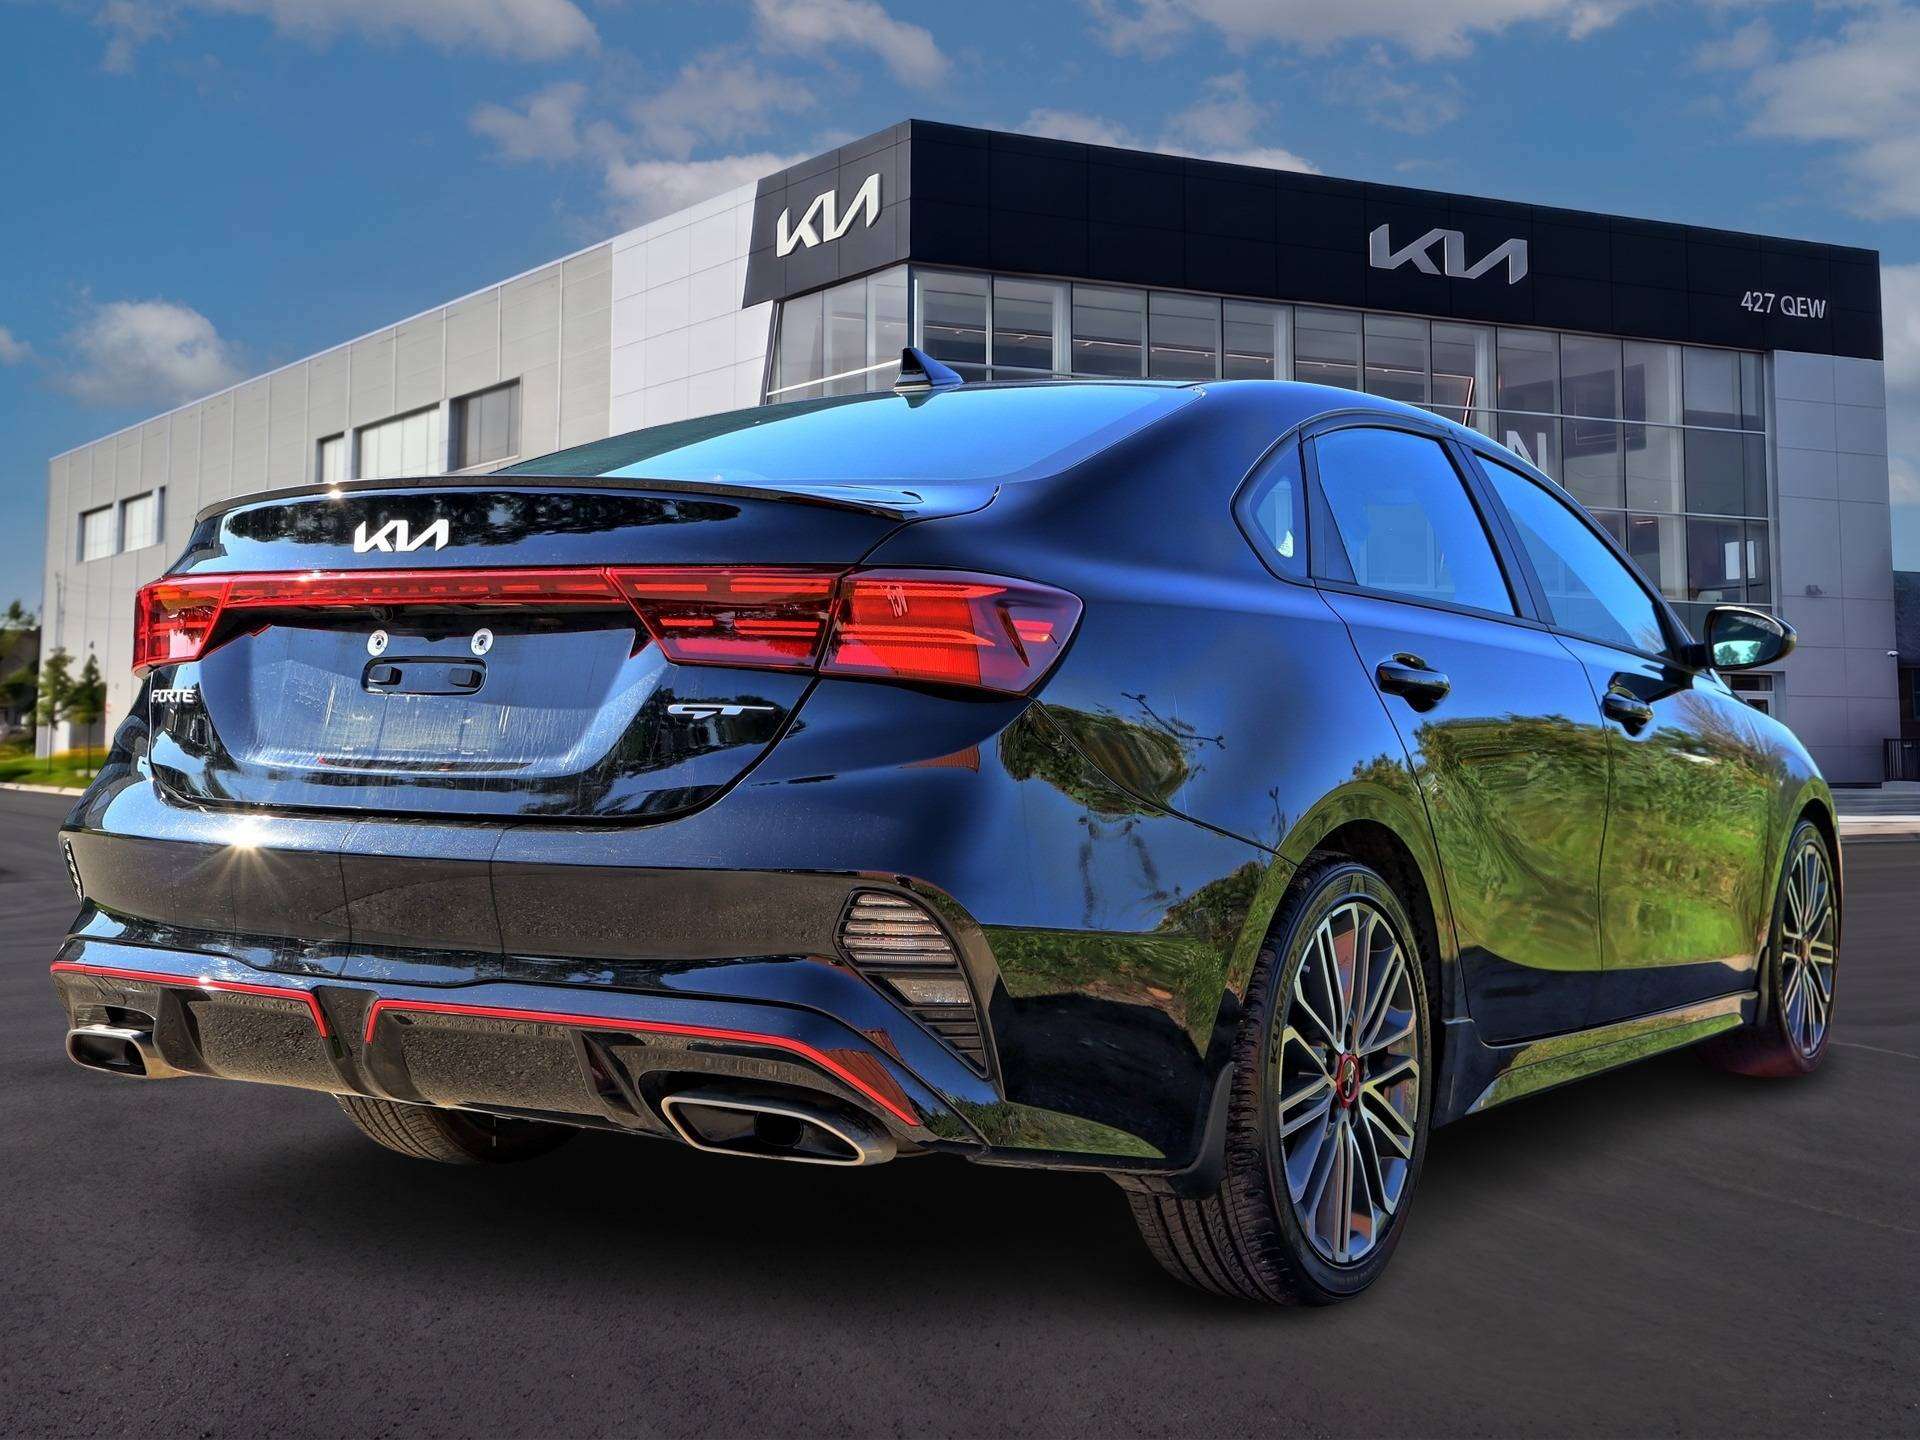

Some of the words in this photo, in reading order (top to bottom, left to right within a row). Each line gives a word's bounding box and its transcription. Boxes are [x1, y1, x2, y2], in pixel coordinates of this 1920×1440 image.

[776, 173, 881, 258] KIA
[1369, 223, 1528, 286] KIA
[1740, 291, 1776, 314] 427
[1780, 295, 1826, 319] QEW
[353, 518, 449, 553] KIA
[151, 688, 197, 703] FORTE
[667, 704, 775, 720] GT
